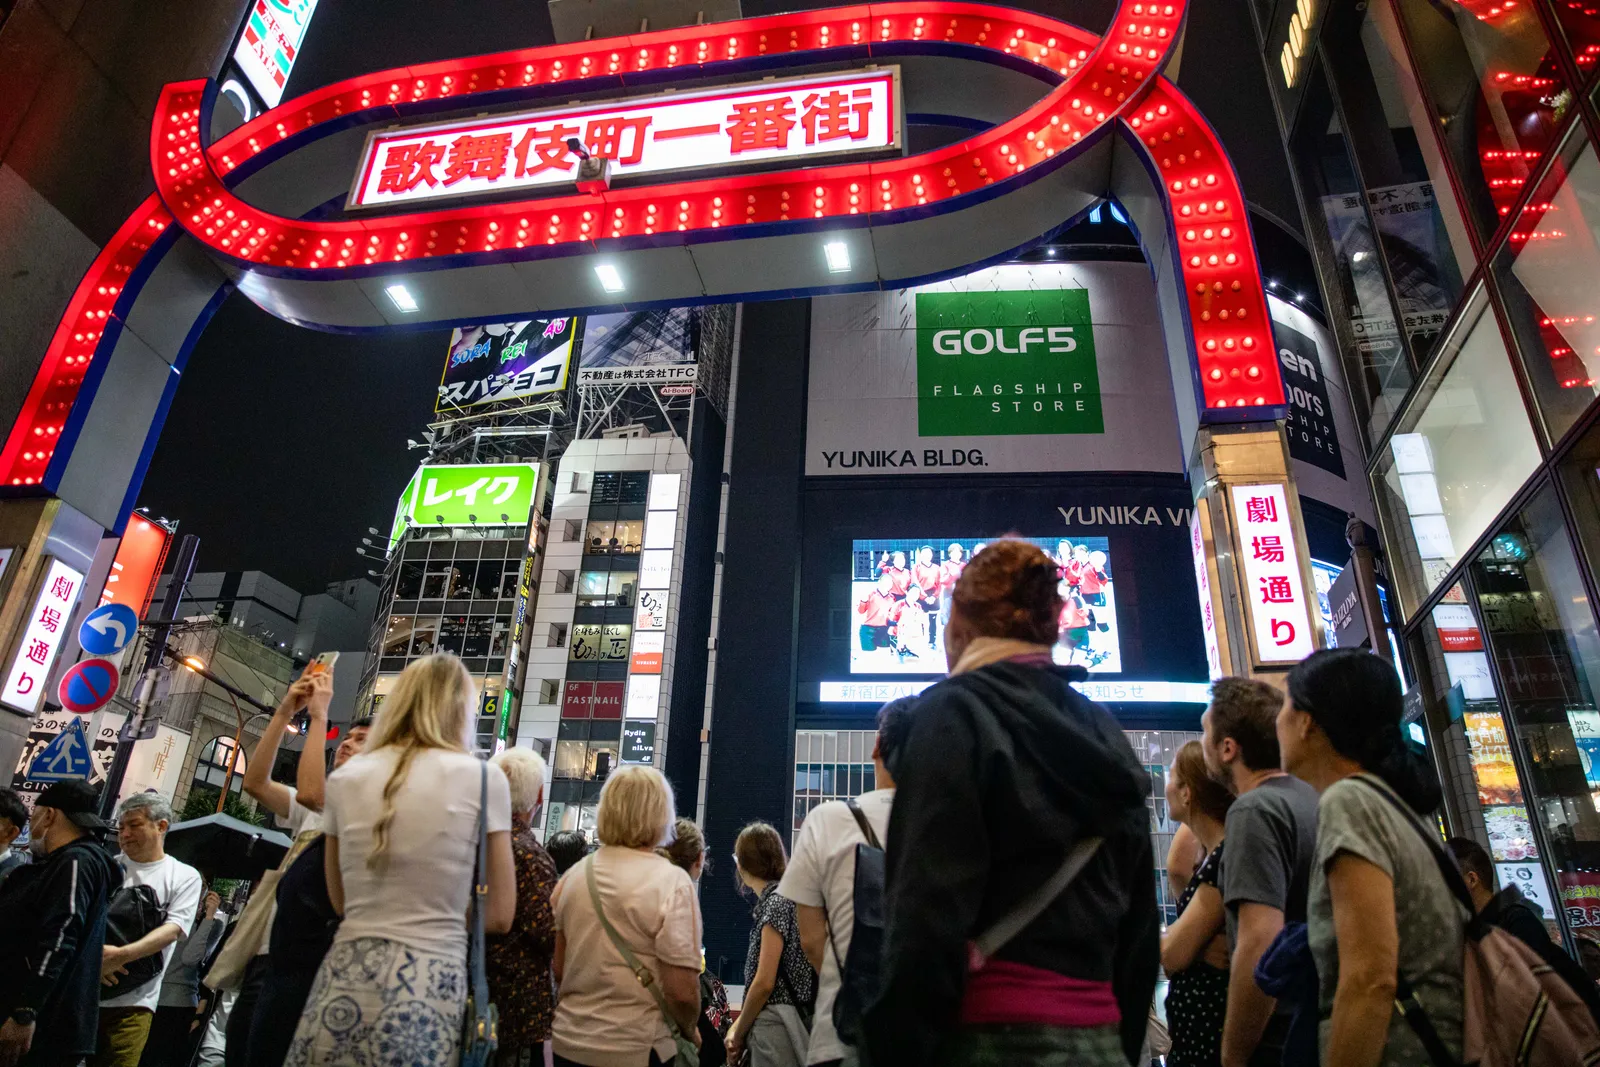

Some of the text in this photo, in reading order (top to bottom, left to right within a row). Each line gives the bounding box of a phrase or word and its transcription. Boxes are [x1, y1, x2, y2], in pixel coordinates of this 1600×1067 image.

[254, 38, 277, 77] ATM
[377, 87, 873, 194] 歌舞伎町一番街
[450, 337, 492, 369] SORA
[500, 339, 528, 365] REI
[932, 326, 1077, 355] GOLF5
[581, 367, 695, 381] 不動産は株式会社TFC
[934, 382, 1082, 396] FLAGSHIP
[991, 400, 1084, 412] STORE
[822, 449, 989, 468] YUNIKA BLDG.
[423, 476, 520, 506] レイク
[1057, 506, 1163, 526] YUNIKA
[1245, 495, 1296, 647] 劇場通り
[17, 575, 75, 695] 劇場通り
[566, 696, 620, 705] FASTNAIL
